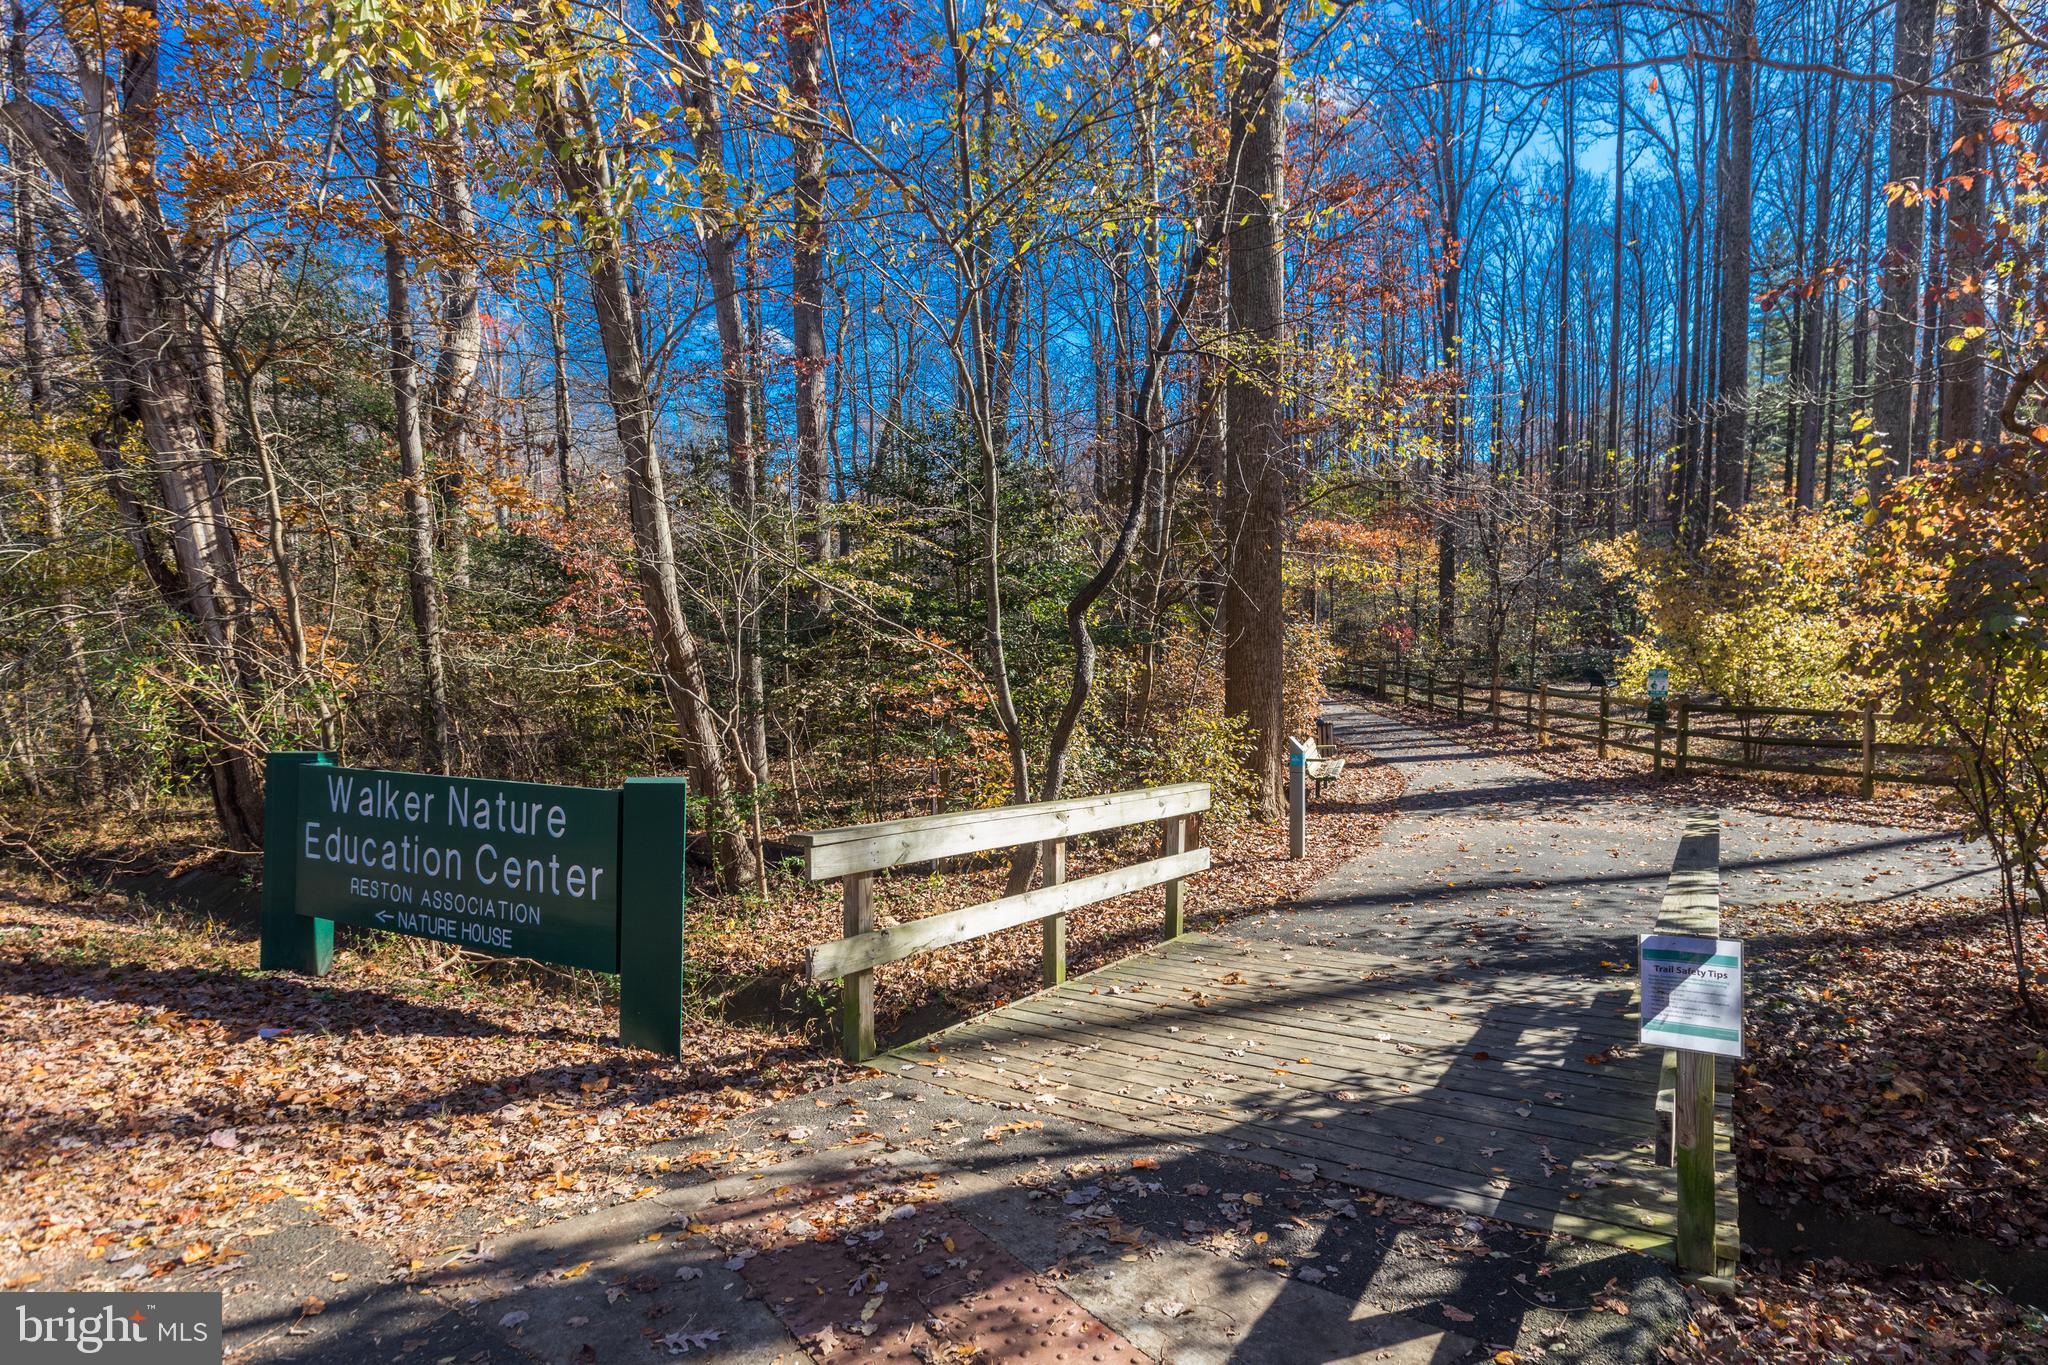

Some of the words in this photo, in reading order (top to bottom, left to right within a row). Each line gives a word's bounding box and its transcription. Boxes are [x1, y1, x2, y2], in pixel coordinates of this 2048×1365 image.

[328, 775, 434, 823] Walker
[448, 785, 566, 838] Nature
[305, 822, 461, 880] Education
[475, 844, 604, 900] Center
[350, 877, 412, 904] RESTON
[420, 889, 541, 925] ASSOCIATION
[397, 912, 456, 939] NATURE
[461, 922, 513, 949] HOUSE
[1654, 965, 1674, 973] Trail
[1676, 966, 1706, 978] Safety
[1708, 969, 1728, 980] Tips
